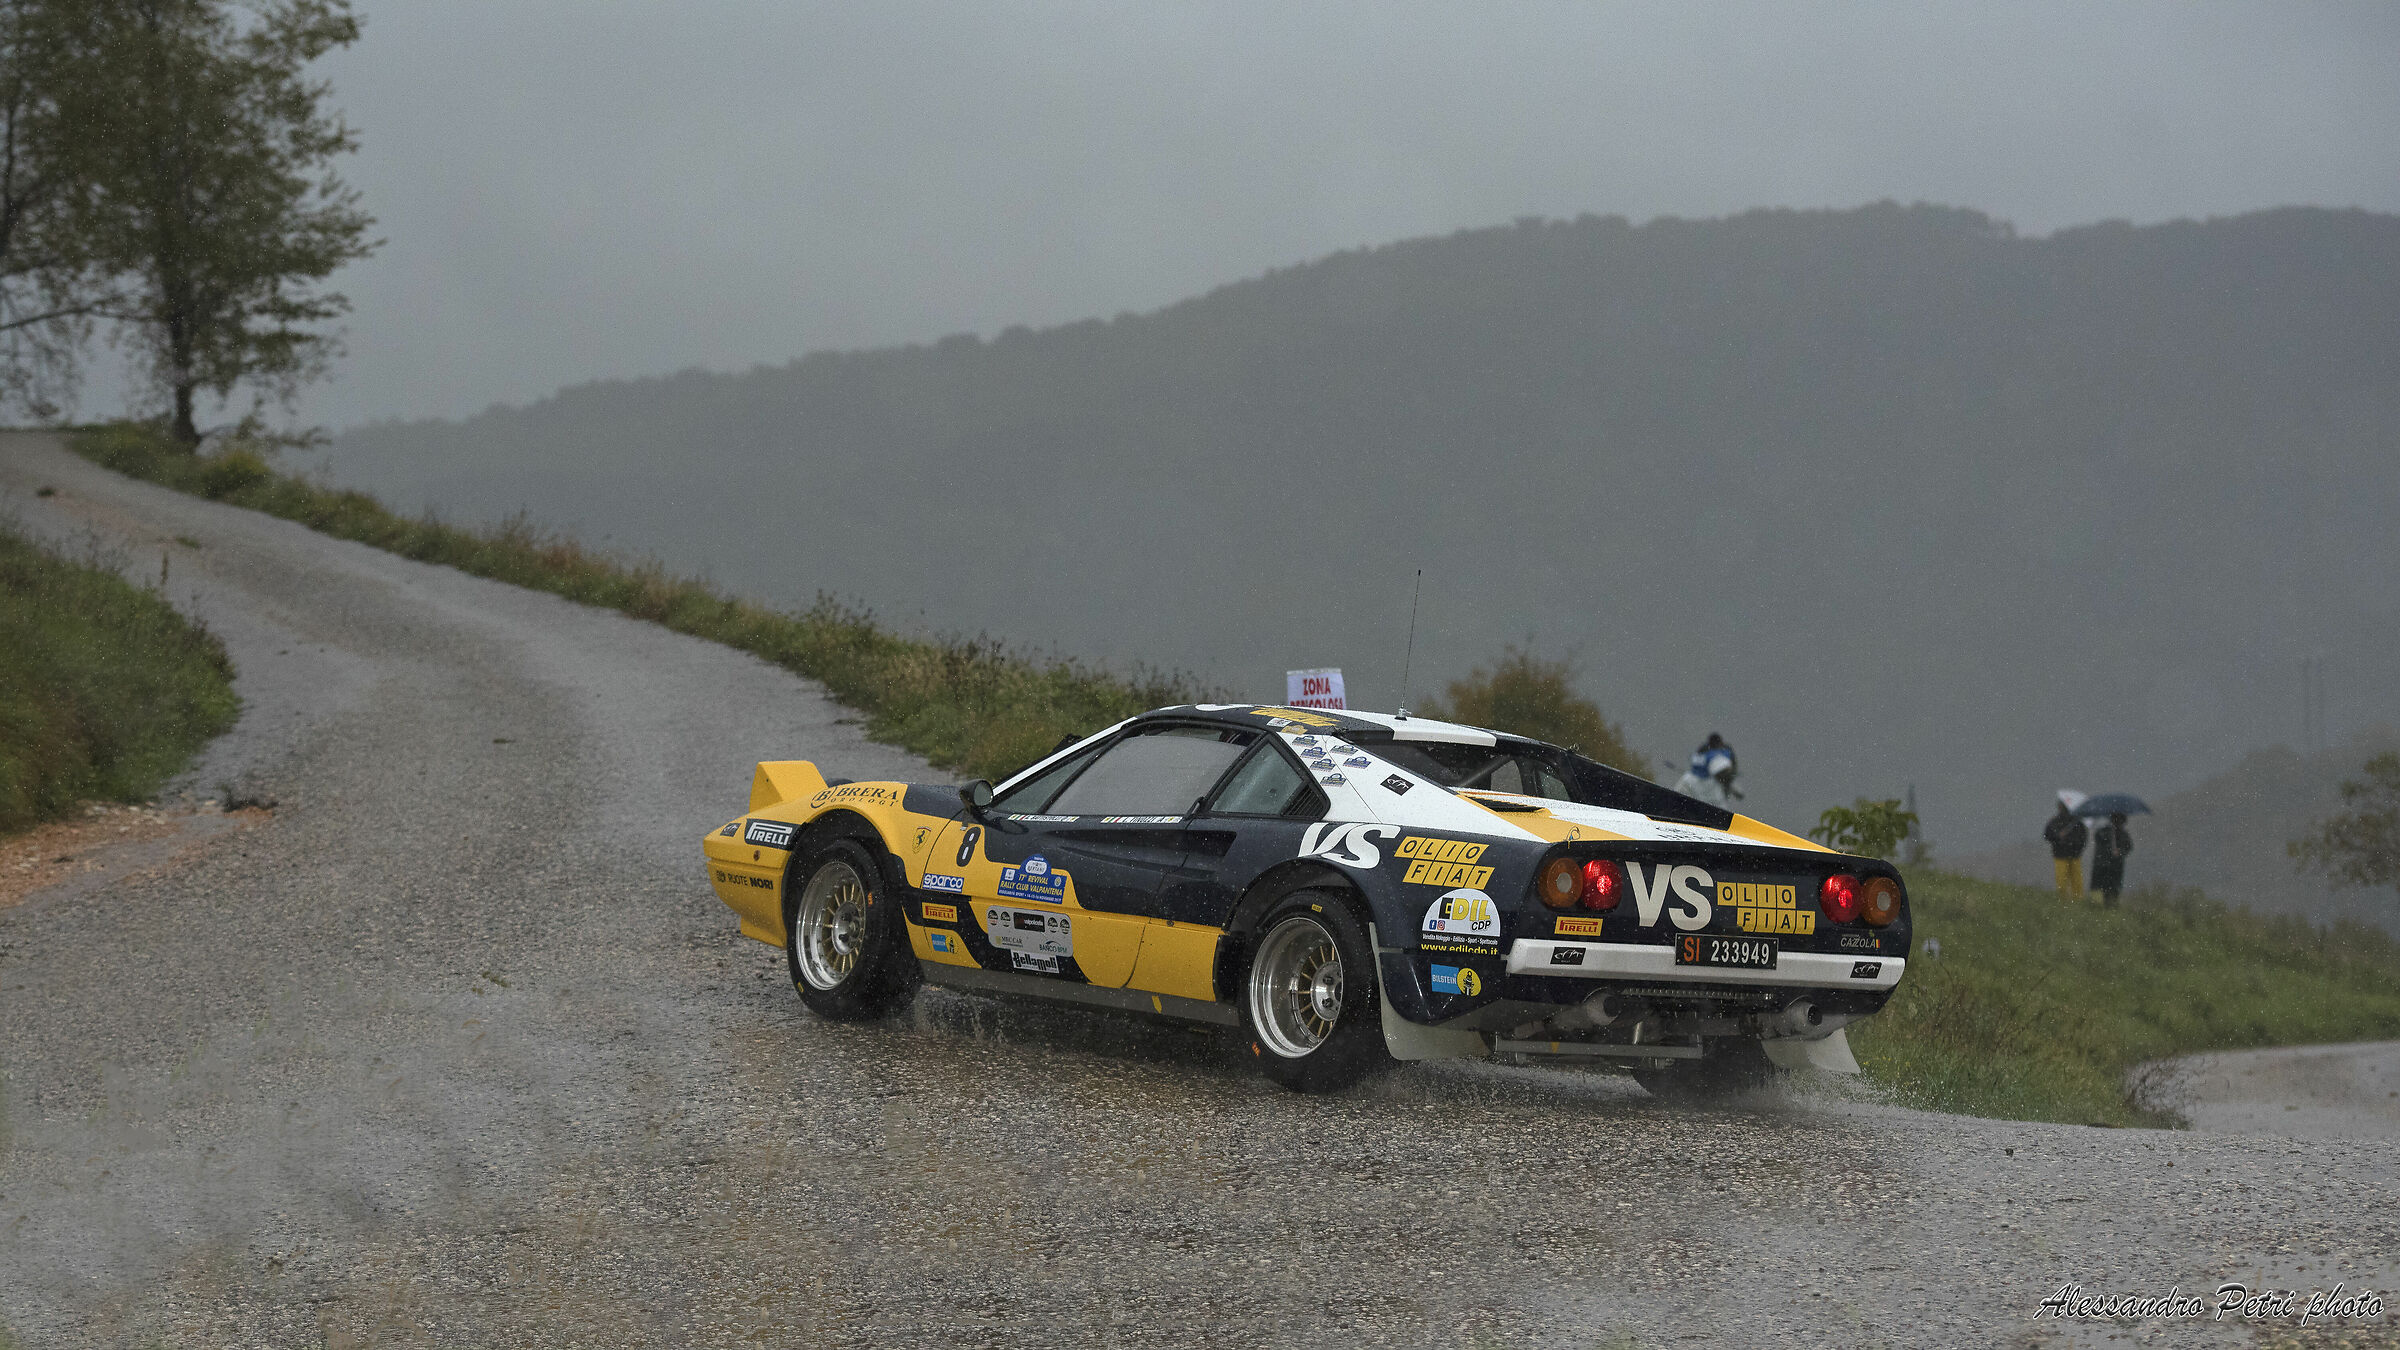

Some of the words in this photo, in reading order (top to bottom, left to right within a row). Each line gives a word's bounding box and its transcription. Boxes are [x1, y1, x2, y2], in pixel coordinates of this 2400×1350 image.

[1303, 677, 1331, 696] ZONA
[829, 796, 899, 807] OROLOGI
[836, 785, 899, 801] BRERA
[747, 822, 794, 846] PIRELLI
[956, 826, 981, 868] 8
[1297, 822, 1401, 869] VS
[1403, 840, 1481, 860] OLIO
[728, 873, 749, 887] RUOTE
[923, 873, 963, 890] sparco
[1027, 875, 1049, 885] REVIVAL
[1411, 864, 1487, 885] FIAT
[1000, 880, 1016, 889] RALLY
[1015, 883, 1029, 891] CLUB
[1030, 885, 1063, 896] VALPANTENA
[1625, 861, 1713, 931] VS
[1722, 886, 1792, 904] OLIO
[925, 905, 954, 919] PIRELLI
[1439, 897, 1491, 921] EDIL
[1471, 920, 1492, 931] CDP
[1559, 919, 1599, 934] PIRELLI
[1741, 911, 1811, 930] FIAT
[1683, 937, 1700, 962] SI
[1711, 940, 1770, 965] 233949
[1840, 937, 1876, 949] CAZZOLA
[1432, 974, 1457, 984] BILSTEIN
